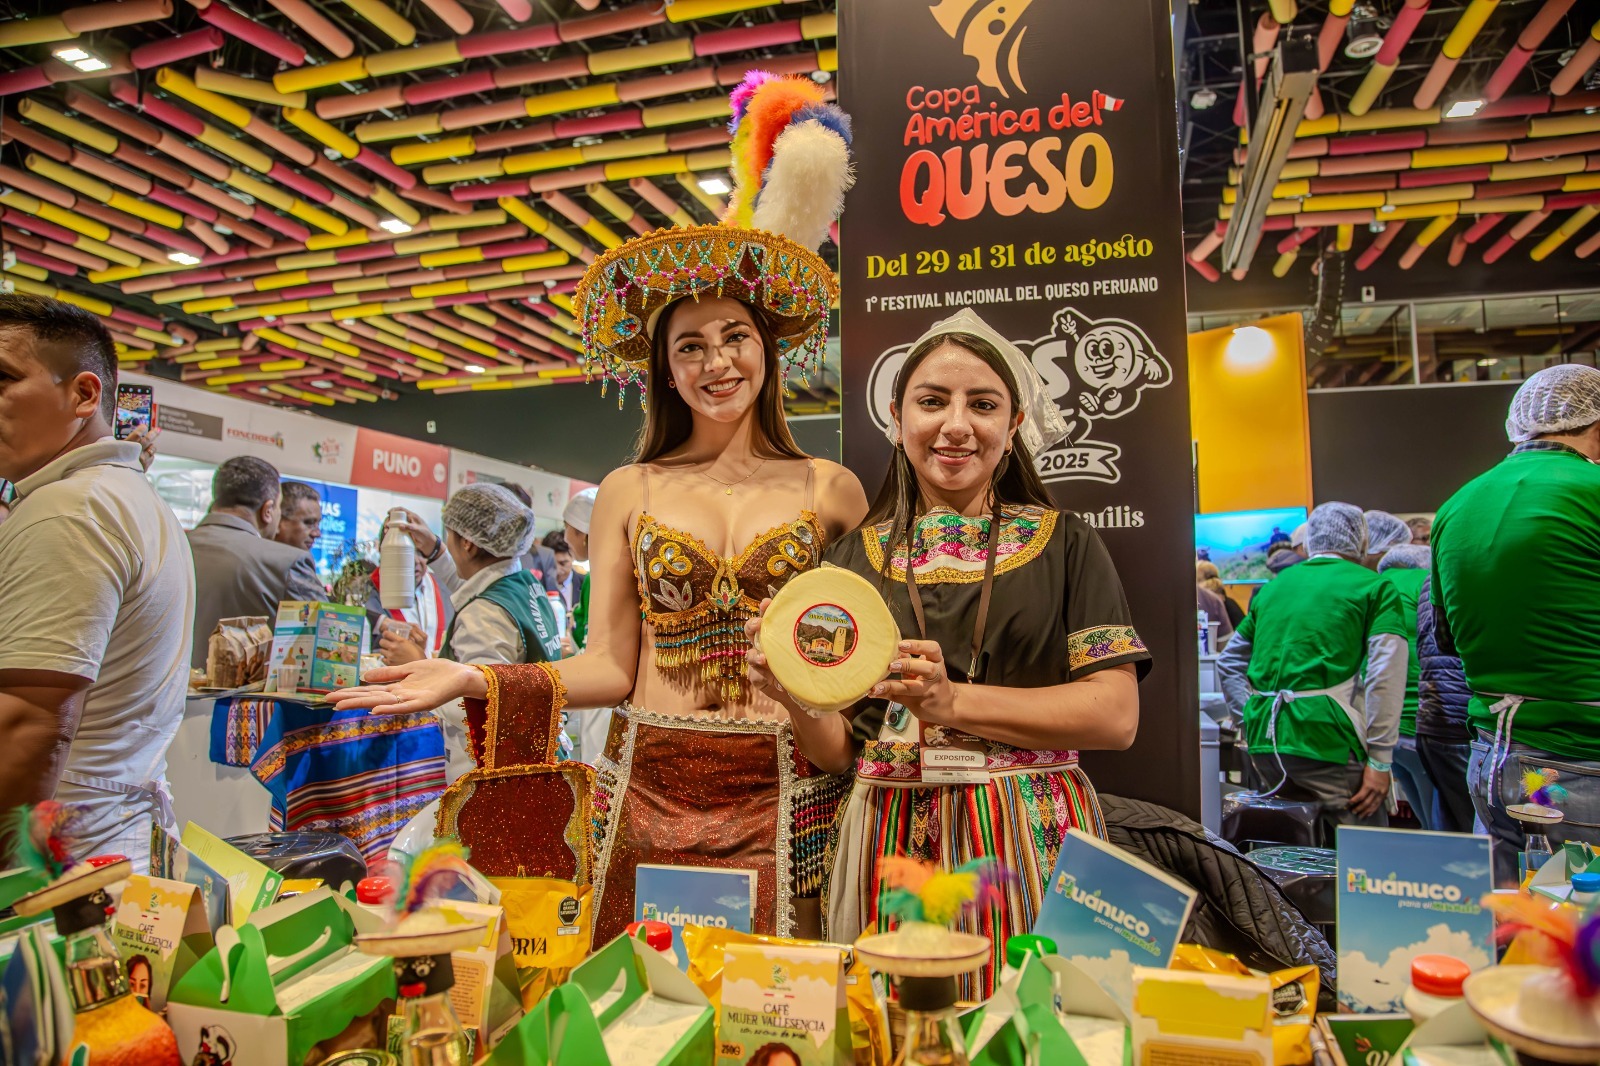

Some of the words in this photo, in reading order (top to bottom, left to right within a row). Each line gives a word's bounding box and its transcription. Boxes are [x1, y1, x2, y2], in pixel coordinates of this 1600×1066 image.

[906, 84, 980, 114] Copa
[904, 102, 1040, 146] América
[1047, 90, 1103, 130] del
[900, 132, 1114, 226] QUESO
[866, 253, 908, 279] Del
[916, 249, 950, 274] 29
[958, 247, 982, 271] al
[990, 244, 1016, 268] 31
[1024, 242, 1056, 265] de
[1064, 233, 1154, 267] agosto
[881, 291, 942, 311] FESTIVAL
[945, 287, 1013, 307] NACIONAL
[1016, 284, 1042, 301] DEL
[1045, 281, 1090, 300] QUESO
[1093, 276, 1158, 296] PERUANO
[372, 448, 421, 478] PUNO
[1040, 452, 1090, 472] 2025
[934, 754, 976, 762] EXPOSITOR
[1347, 871, 1461, 902] Huánuco
[642, 905, 728, 929] Huánuco
[1055, 875, 1150, 938] Huánuco
[727, 1012, 758, 1026] MUJER
[762, 1015, 826, 1033] VALLESENCIA
[763, 1003, 790, 1016] CAFÉ
